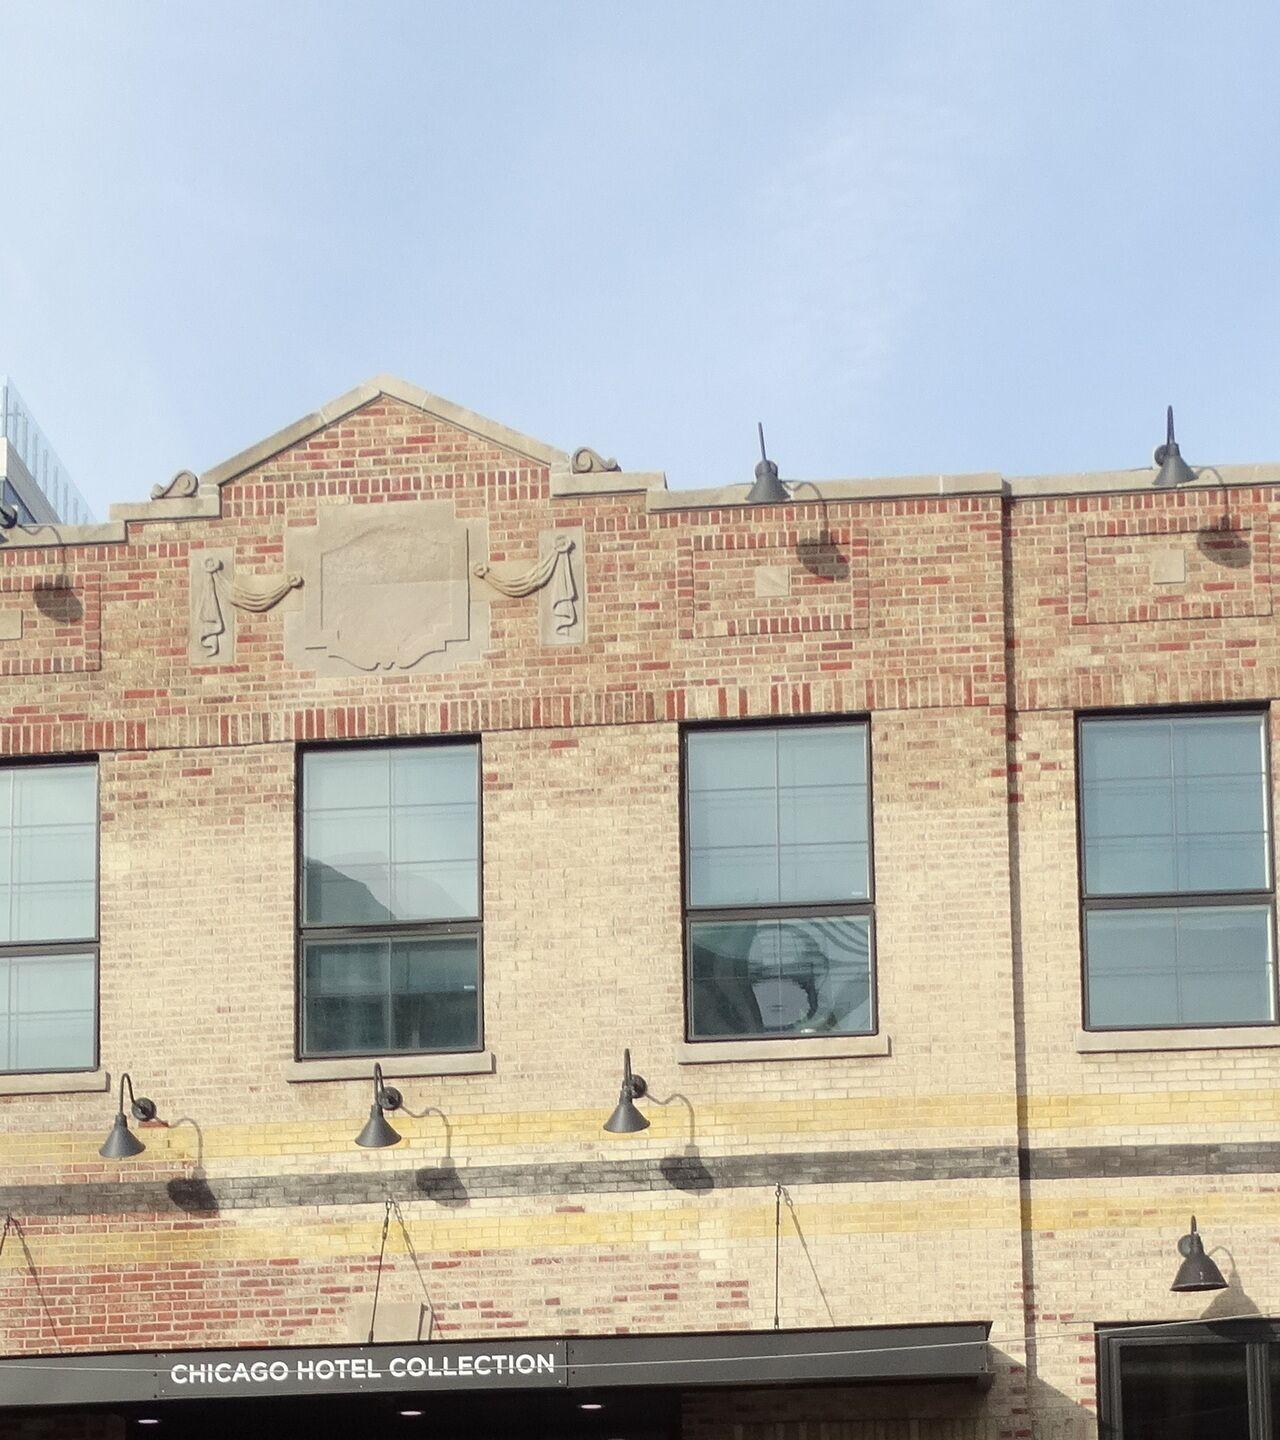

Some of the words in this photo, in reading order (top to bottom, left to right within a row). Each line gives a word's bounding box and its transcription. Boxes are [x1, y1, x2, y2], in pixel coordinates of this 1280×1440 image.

[170, 1361, 289, 1384] CHICAGO
[297, 1358, 382, 1381] HOTEL
[388, 1353, 556, 1378] COLLECTION
